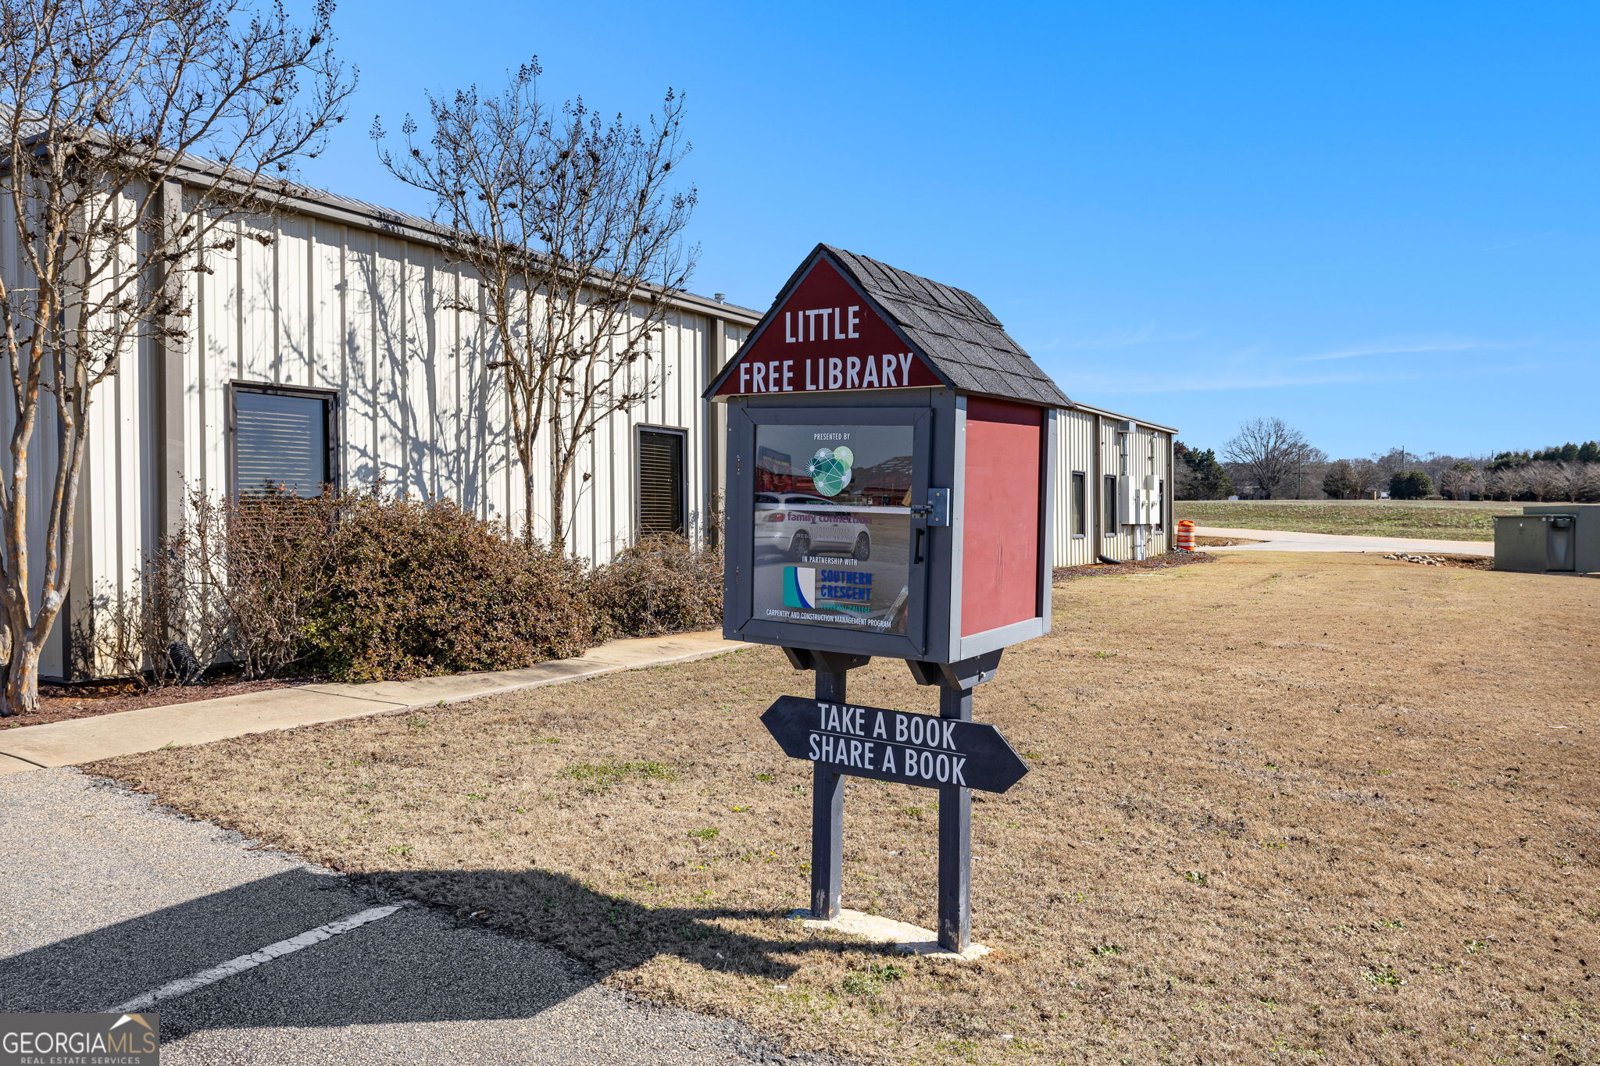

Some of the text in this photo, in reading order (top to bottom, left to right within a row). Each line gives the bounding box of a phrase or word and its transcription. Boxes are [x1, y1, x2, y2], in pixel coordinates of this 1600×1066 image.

[785, 305, 860, 343] LITTLE
[740, 352, 914, 394] FREE LIBRARY
[787, 511, 816, 524] family
[809, 556, 843, 565] PARTNERSHIP
[820, 569, 873, 585] SOUTHERN
[820, 584, 872, 601] CRESCENT
[766, 608, 790, 617] CARPENTRY
[801, 612, 834, 622] CONSTRUCTION
[835, 615, 867, 625] MANAGEMENT
[868, 618, 892, 628] PROGRAM
[817, 702, 957, 750] TAKE A BOOK
[808, 733, 967, 787] SHARE A BOOK
